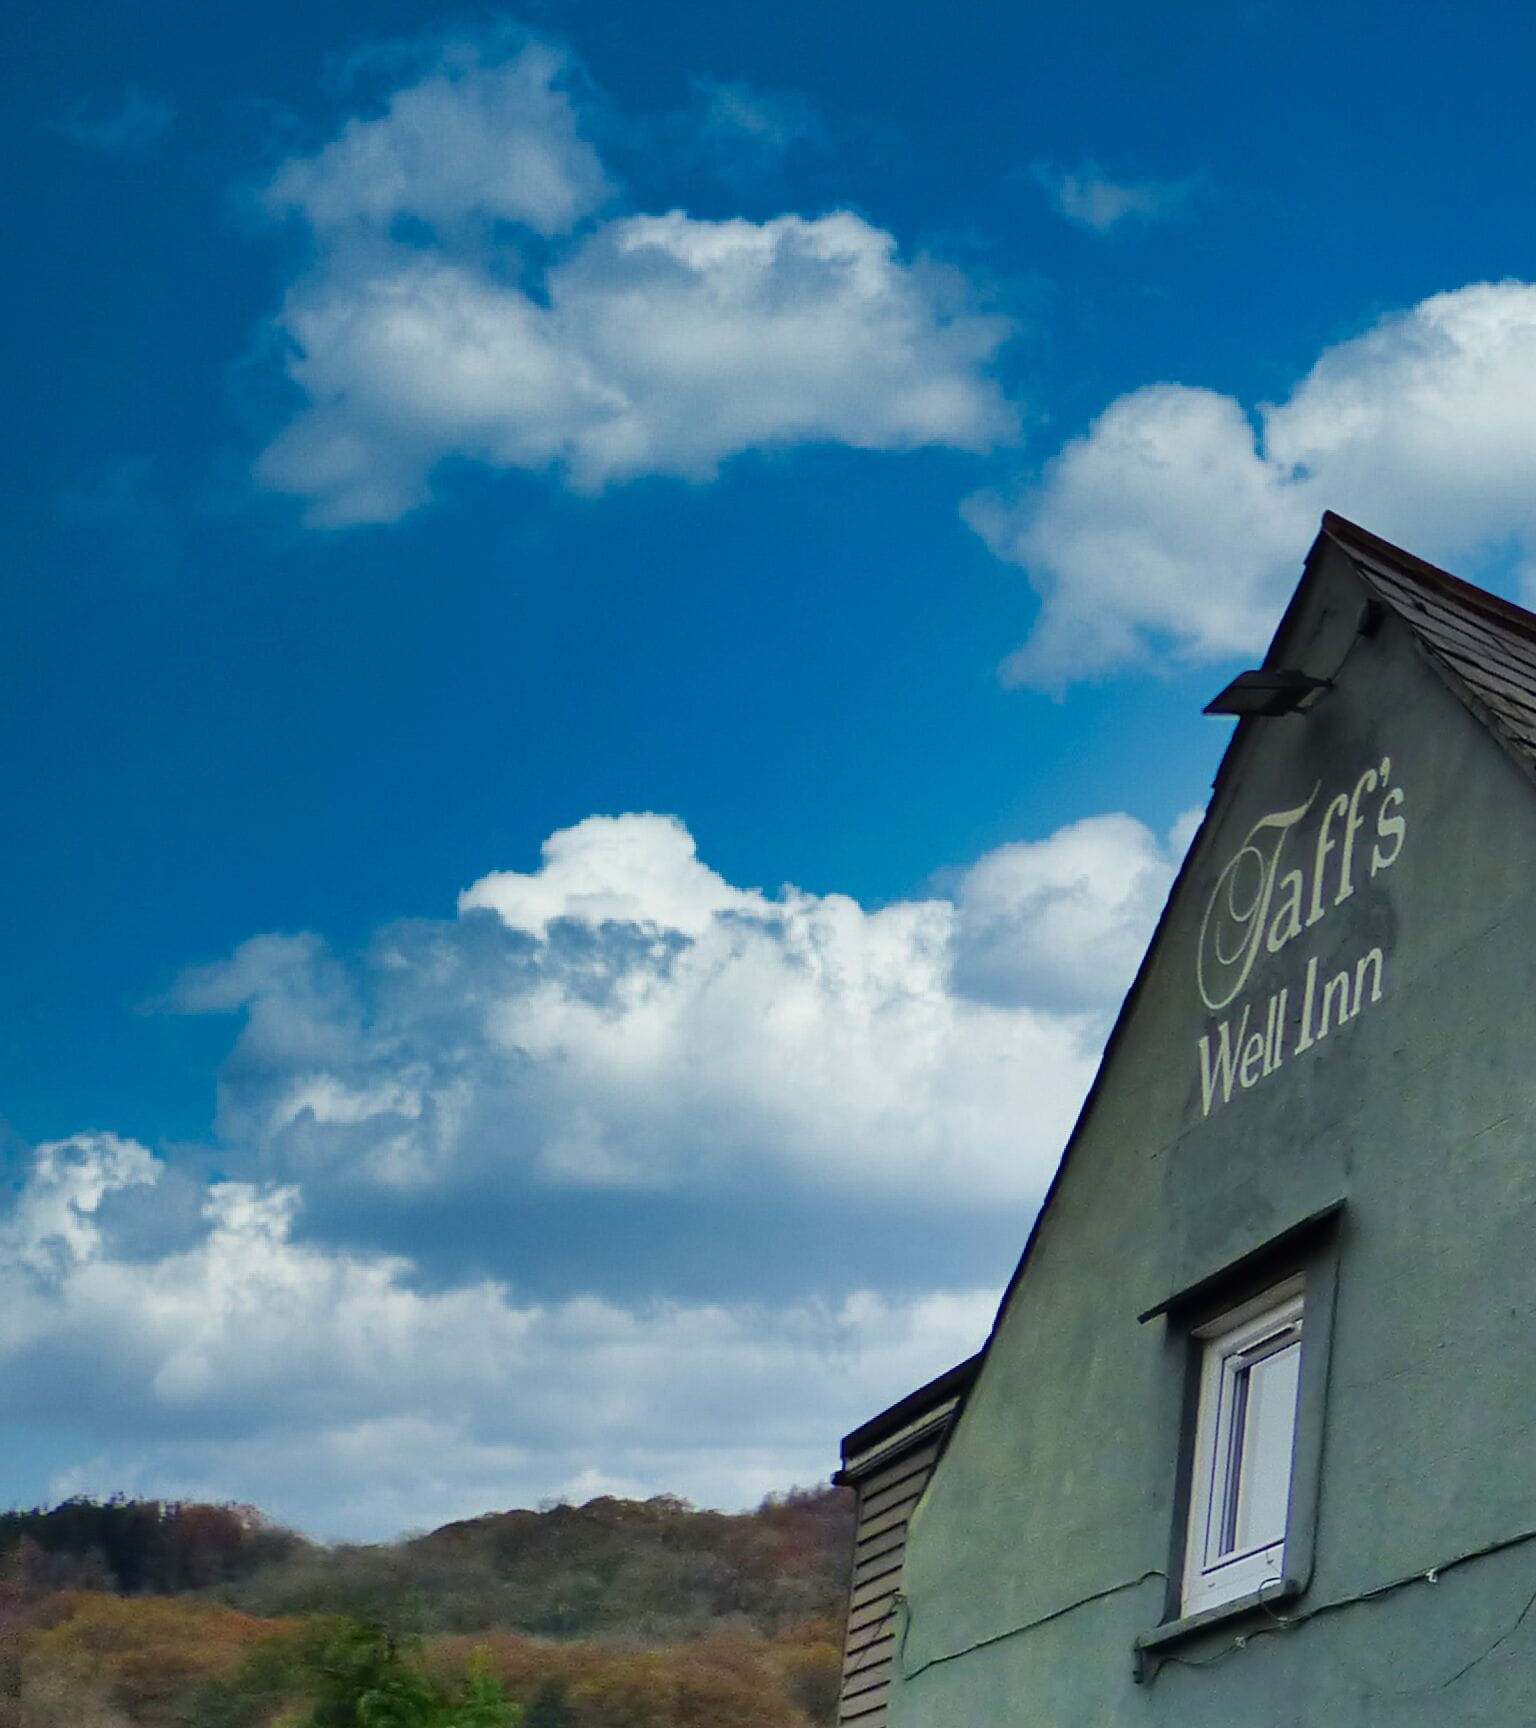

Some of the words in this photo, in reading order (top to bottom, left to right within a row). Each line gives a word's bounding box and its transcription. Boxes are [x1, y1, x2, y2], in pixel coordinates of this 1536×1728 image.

[1197, 756, 1406, 1010] Taff's
[1199, 988, 1288, 1118] Well
[1294, 947, 1384, 1056] Inn
